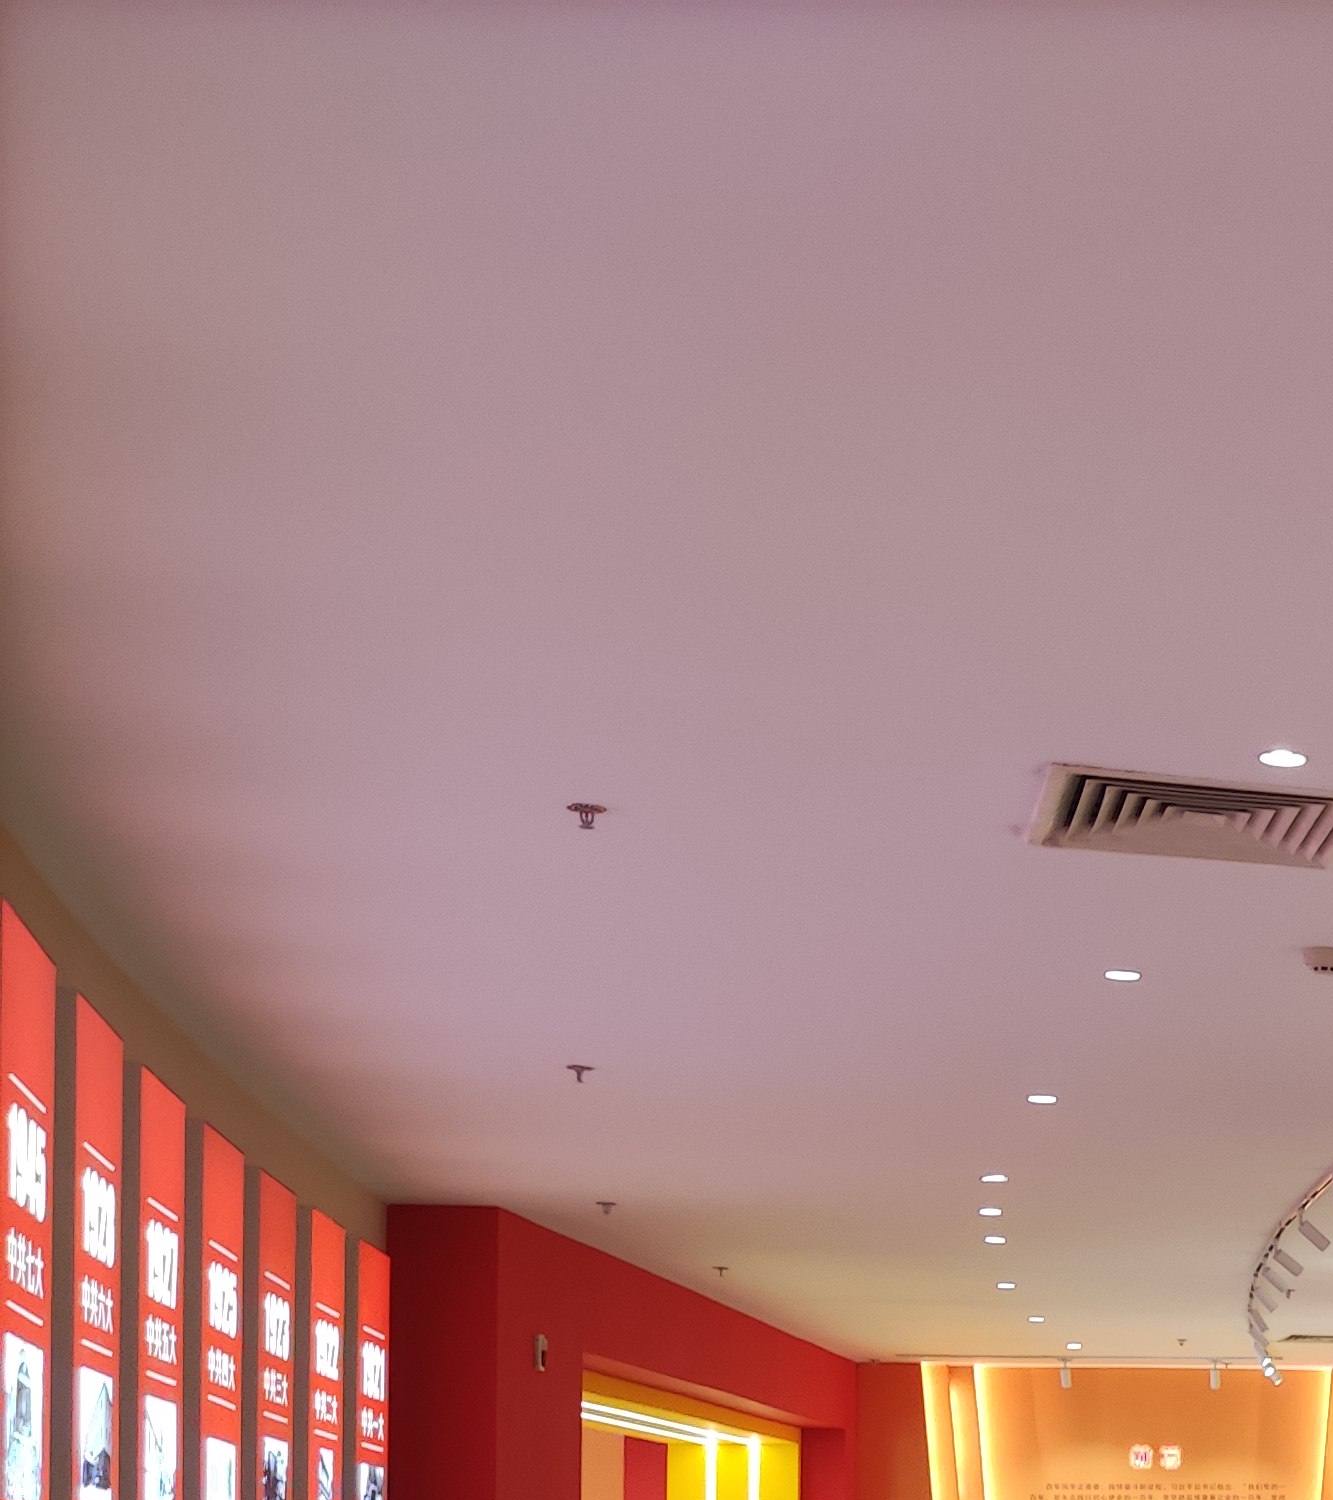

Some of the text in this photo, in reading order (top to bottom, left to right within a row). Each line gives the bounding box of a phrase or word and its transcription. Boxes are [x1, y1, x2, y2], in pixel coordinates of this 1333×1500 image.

[8, 1103, 47, 1223] 1945
[7, 1227, 44, 1299] 中共七大
[81, 1274, 113, 1333] 中共六大
[145, 1314, 177, 1366] 中共五大
[207, 1345, 236, 1392] 中共四大
[263, 1366, 289, 1407] 中共三大
[314, 1387, 338, 1425] 中共二大
[361, 1405, 385, 1442] 中共一大
